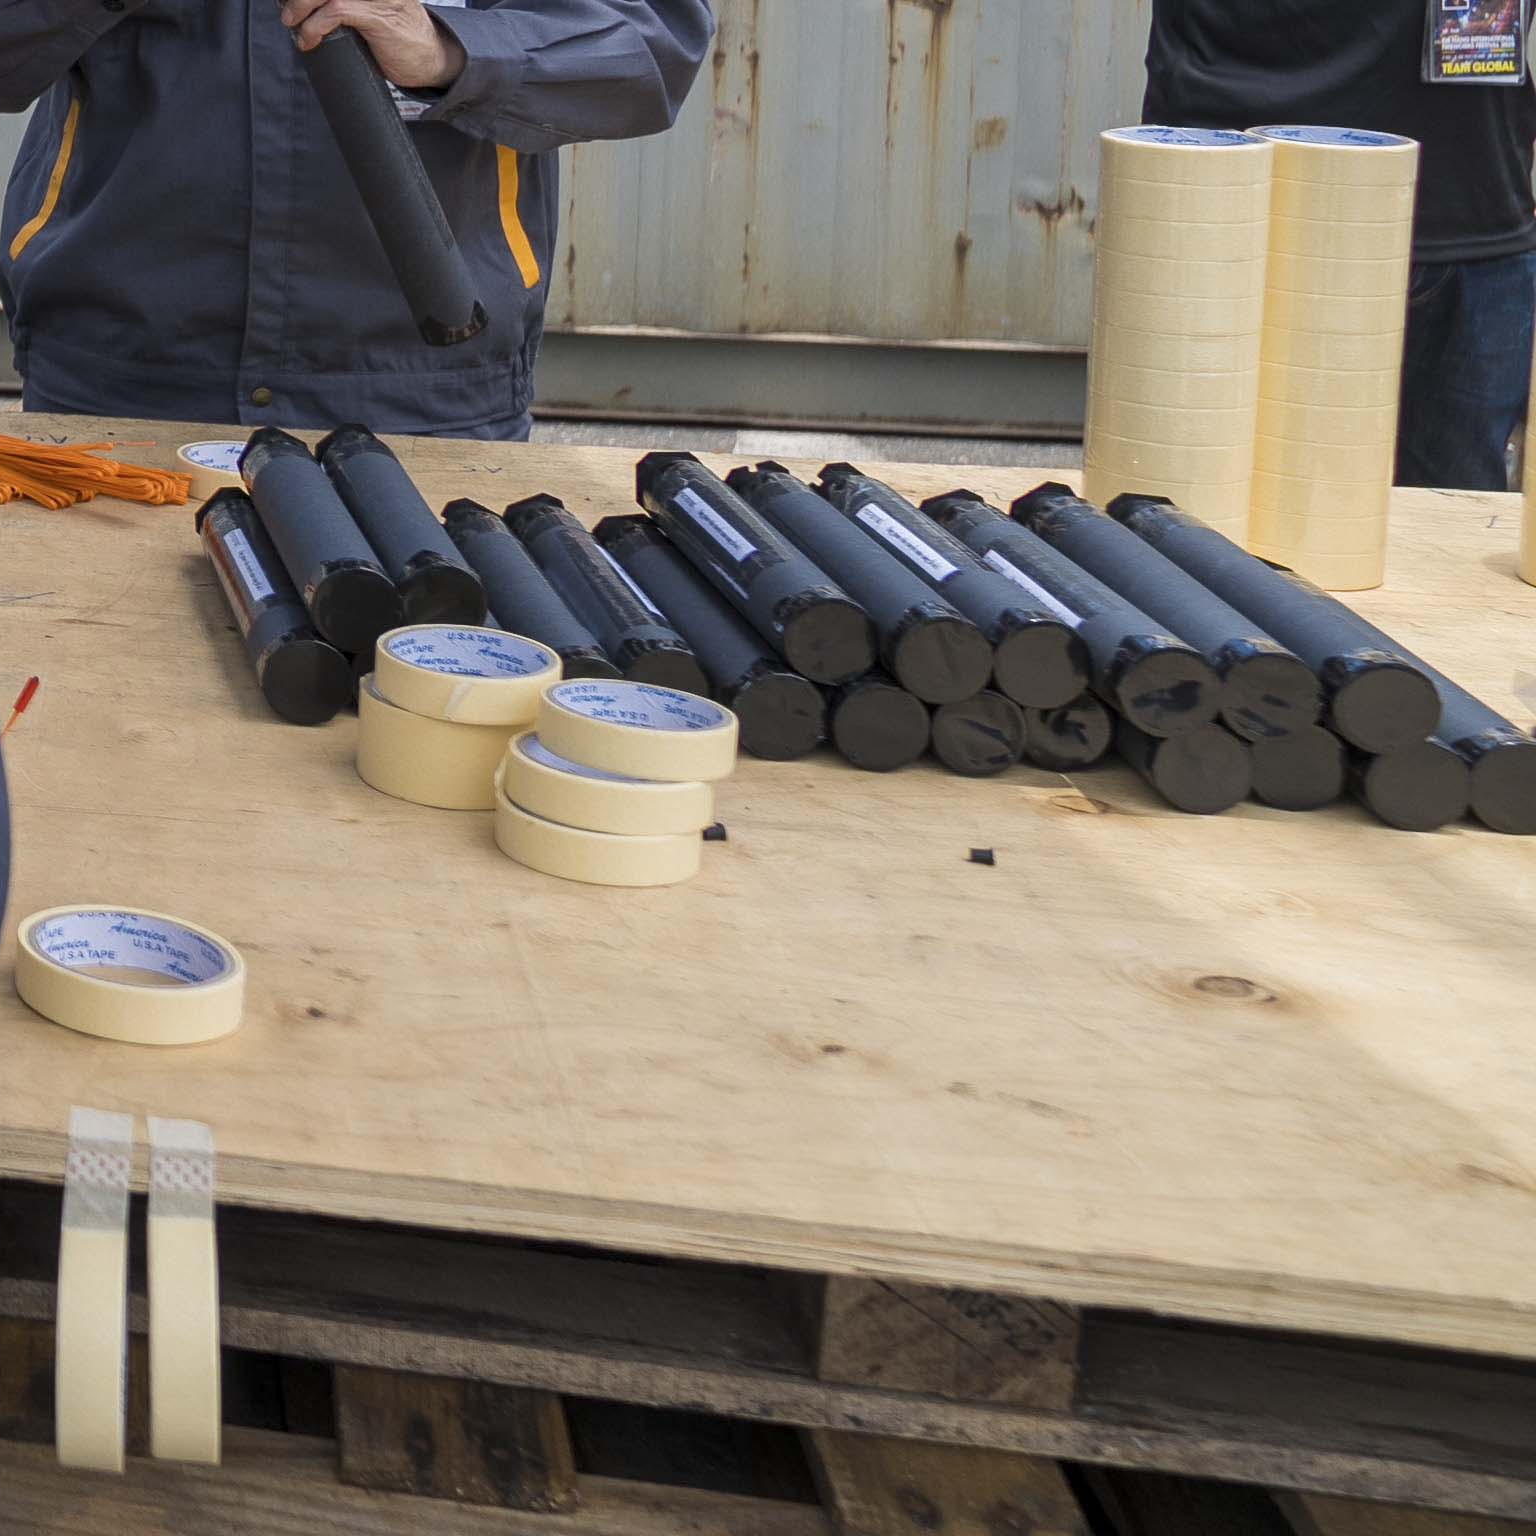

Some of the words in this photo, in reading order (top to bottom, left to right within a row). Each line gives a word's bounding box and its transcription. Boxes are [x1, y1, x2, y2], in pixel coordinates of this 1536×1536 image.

[1442, 62, 1471, 74] TEAM
[1472, 60, 1515, 73] GLOBAL
[477, 635, 503, 647] TAPE
[87, 949, 117, 960] TAPE
[163, 944, 191, 964] TAPE
